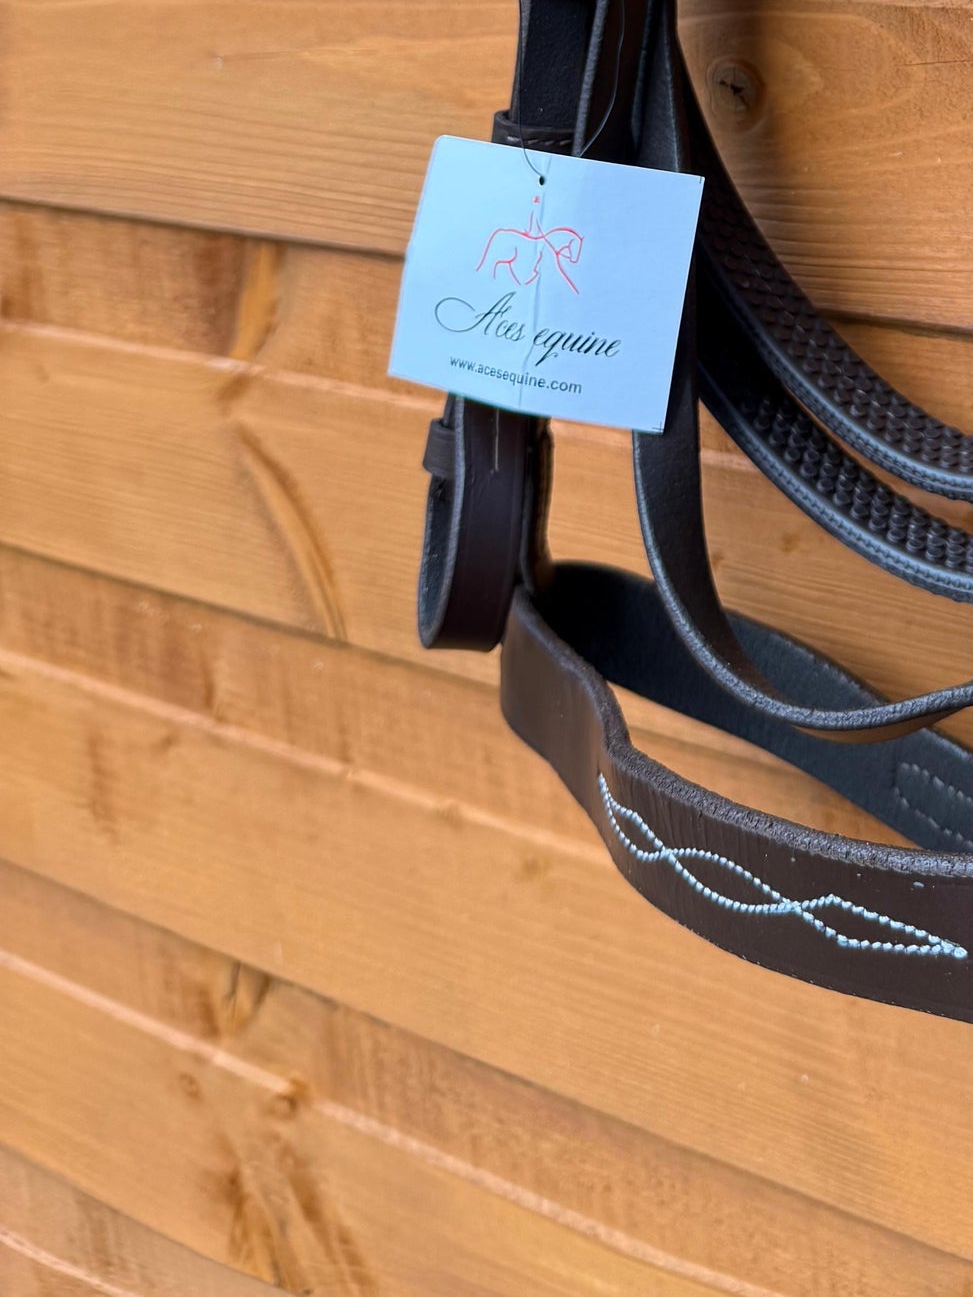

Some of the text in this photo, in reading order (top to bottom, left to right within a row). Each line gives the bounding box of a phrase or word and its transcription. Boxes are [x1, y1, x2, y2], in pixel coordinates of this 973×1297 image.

[434, 291, 621, 366] Aces equine
[450, 355, 582, 394] www.acesequine.com
